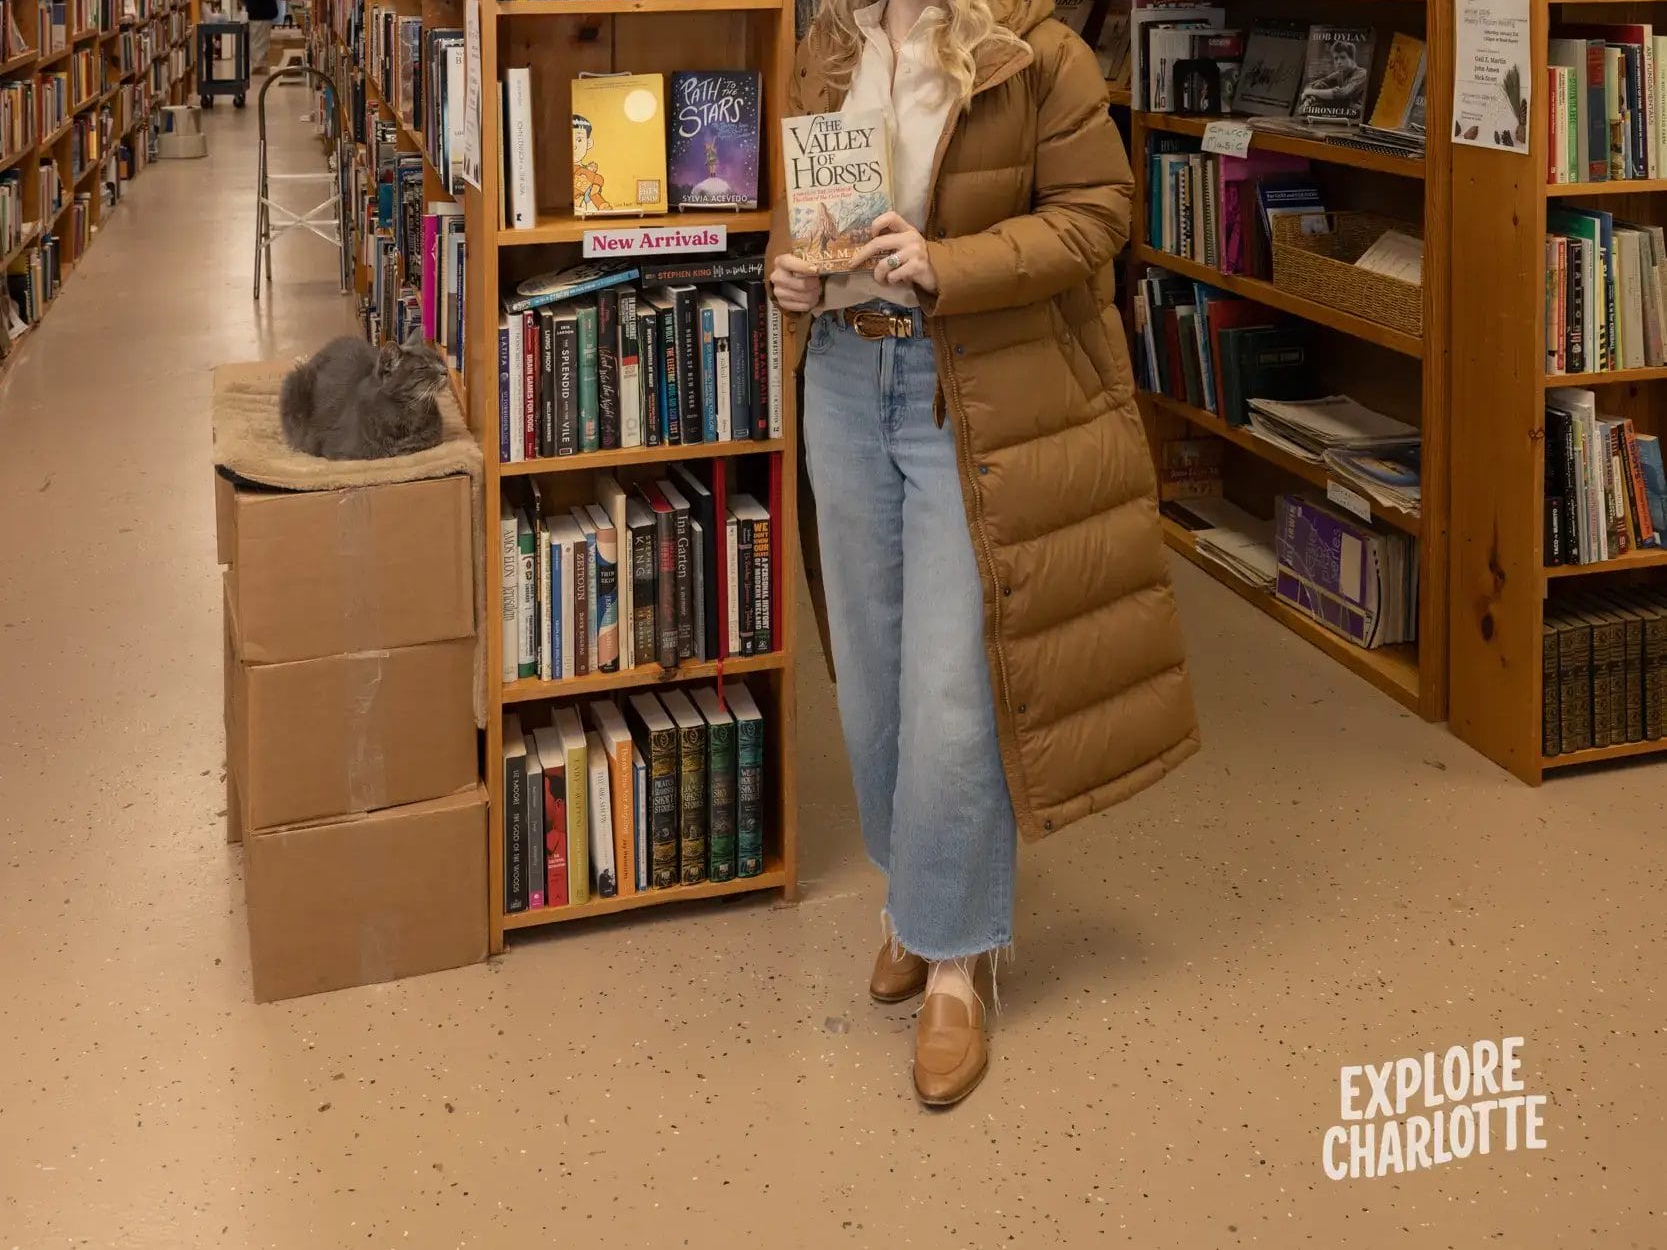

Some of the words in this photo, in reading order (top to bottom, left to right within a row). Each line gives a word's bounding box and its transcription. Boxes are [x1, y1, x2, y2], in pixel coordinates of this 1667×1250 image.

[1313, 33, 1331, 41] BOB
[1334, 33, 1367, 41] DYLAN
[681, 78, 721, 105] PATH
[721, 88, 738, 96] THE
[723, 81, 736, 90] TO
[679, 97, 744, 138] STARS
[1303, 106, 1357, 116] CHRONICLES
[789, 115, 876, 155] VALLEY
[816, 120, 842, 132] THE
[817, 154, 836, 166] OF
[792, 156, 882, 193] HORSES
[682, 194, 708, 202] SYLVIA
[711, 194, 748, 202] ACEVEDO
[592, 235, 636, 251] New
[639, 230, 719, 250] Arrivals
[657, 269, 690, 280] STEPHEN
[692, 268, 712, 278] KING
[666, 326, 674, 343] WOLFE
[501, 336, 509, 366] LATIFA
[666, 347, 674, 357] THE
[561, 350, 570, 399] SPLENDID
[667, 358, 676, 383] ELECTRIC
[600, 385, 614, 397] the
[600, 397, 614, 418] Night
[562, 422, 570, 443] VILE
[677, 516, 688, 534] Ina
[754, 522, 768, 532] WE
[504, 529, 515, 553] AMOS
[504, 556, 515, 578] ELON
[636, 536, 645, 578] KING
[678, 537, 688, 578] Garten
[755, 558, 761, 566] OF
[576, 553, 585, 601] ZEITOUN
[761, 564, 769, 599] PERSONAL
[762, 600, 770, 629] HISTORY
[655, 794, 674, 805] SHORT
